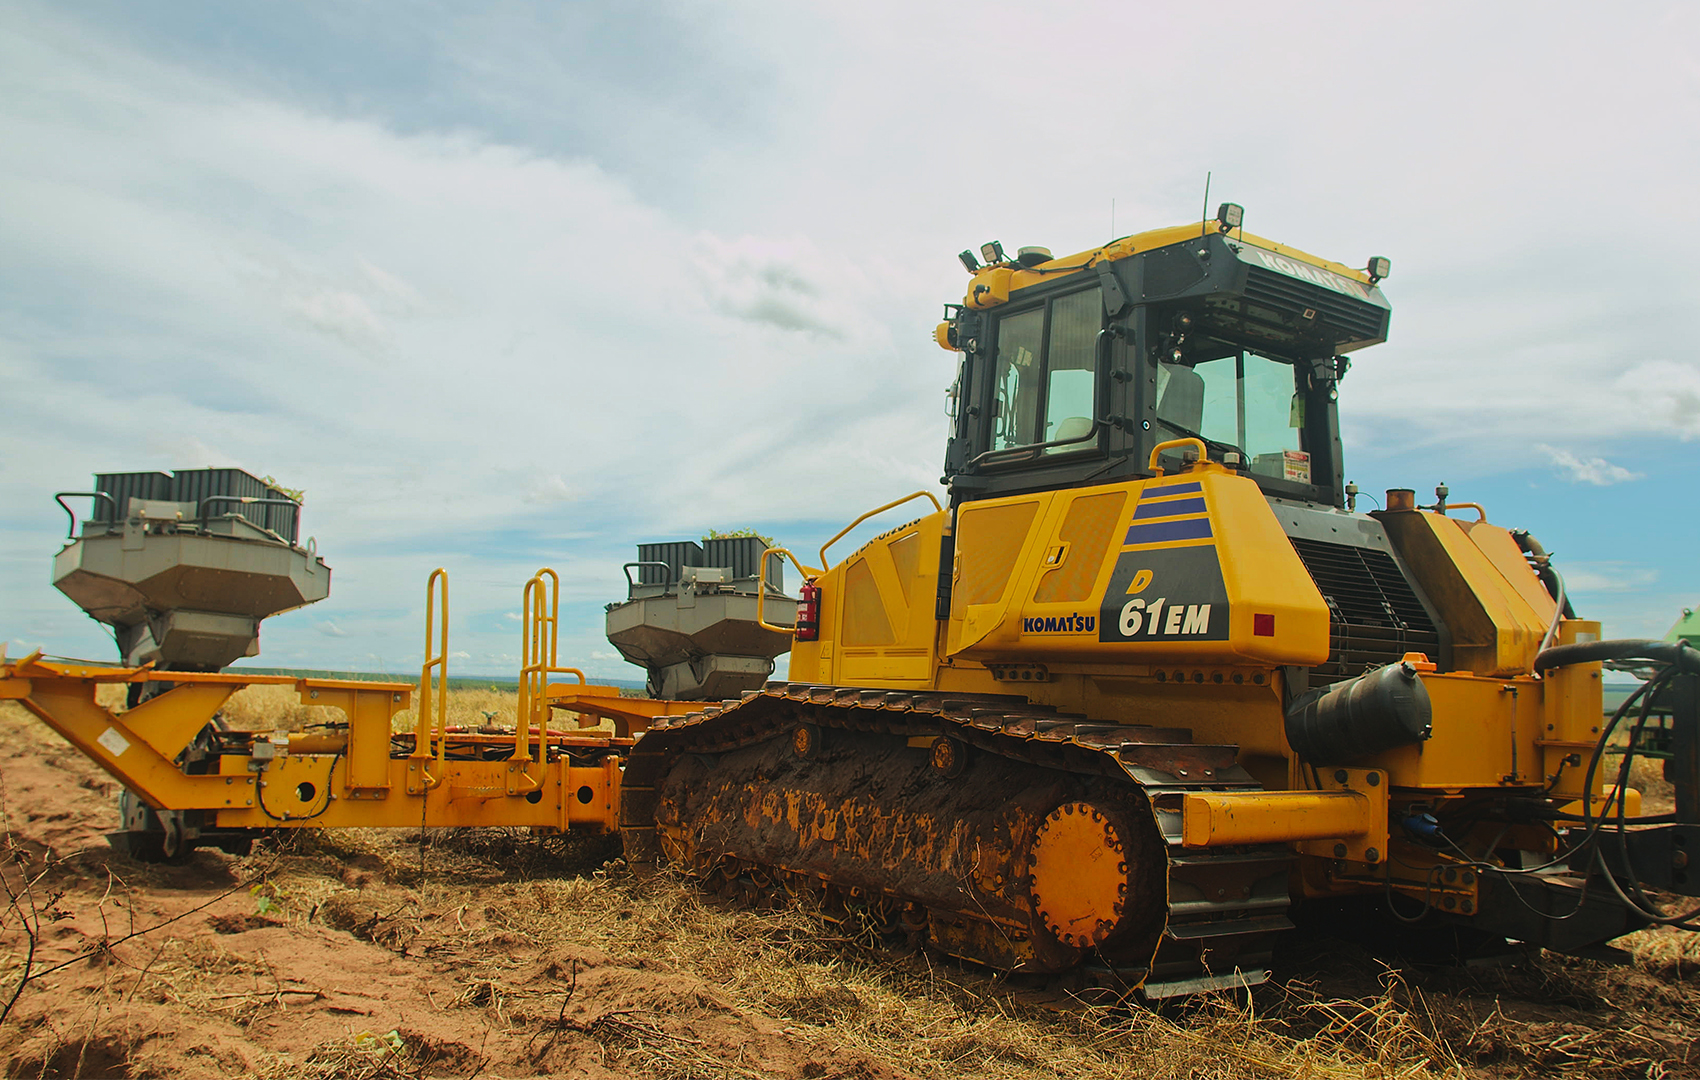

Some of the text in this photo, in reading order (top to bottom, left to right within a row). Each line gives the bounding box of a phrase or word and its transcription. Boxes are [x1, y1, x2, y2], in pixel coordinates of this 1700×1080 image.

[1257, 251, 1369, 298] KOMATSU
[1126, 569, 1153, 594] D
[1023, 612, 1095, 632] KOMATSU
